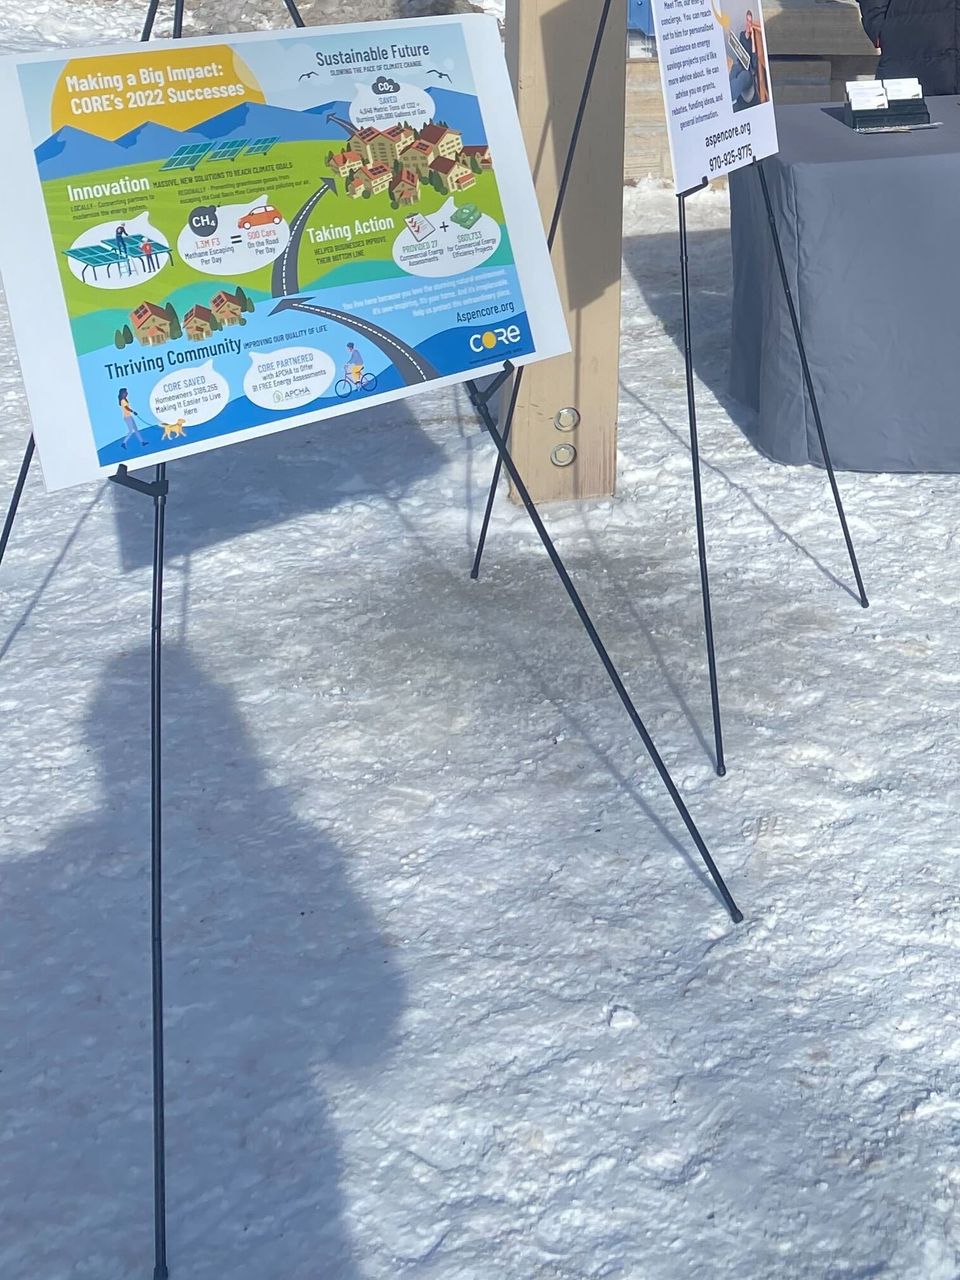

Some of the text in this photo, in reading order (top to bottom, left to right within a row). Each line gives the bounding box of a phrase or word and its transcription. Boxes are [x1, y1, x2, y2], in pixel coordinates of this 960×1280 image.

[316, 45, 430, 66] Sustainable Future
[330, 68, 353, 76] SLOWING
[383, 62, 403, 70] CLIMATE
[404, 60, 422, 68] CHANGE
[65, 63, 224, 92] Making a Big Impact:
[126, 90, 165, 108] 2022
[167, 84, 245, 103] Successes
[379, 96, 397, 105] SAVED
[705, 122, 751, 147] aspencore.org
[709, 143, 752, 172] 970-925-9775
[180, 177, 193, 185] NEW
[194, 172, 225, 182] SOLUTIONS
[234, 168, 252, 177] REACH
[252, 165, 274, 174] CLIMATE
[275, 162, 293, 170] GOALS
[67, 177, 150, 201] Innovation
[247, 231, 260, 240] 500
[306, 217, 394, 244] Taking Action
[265, 237, 279, 245] Road
[314, 236, 386, 255] HELPED BUSINESSES IMPROVE
[454, 240, 481, 250] Commercial
[185, 246, 235, 259] Methane Escaping
[332, 253, 353, 261] BOTTOM
[400, 251, 428, 261] Commercial
[452, 250, 475, 258] Efficiency
[456, 302, 515, 323] Aspencore.org
[243, 337, 272, 350] IMPROVING
[273, 334, 285, 343] OUR
[285, 329, 307, 340] QUALITY
[315, 325, 328, 333] LIFE
[105, 339, 243, 380] Thriving Community
[257, 353, 314, 373] CORE PARTNERED
[258, 382, 273, 391] FREE
[273, 379, 292, 387] Energy
[292, 370, 327, 382] Assessments
[263, 372, 274, 381] with
[275, 368, 293, 378] APCHA
[300, 364, 313, 372] Offer
[163, 376, 206, 393] CORE SAVED
[284, 386, 310, 398] APCHA
[155, 392, 193, 405] Homeowners
[156, 405, 177, 414] Making
[183, 399, 201, 407] Easier
[184, 408, 198, 416] Here
